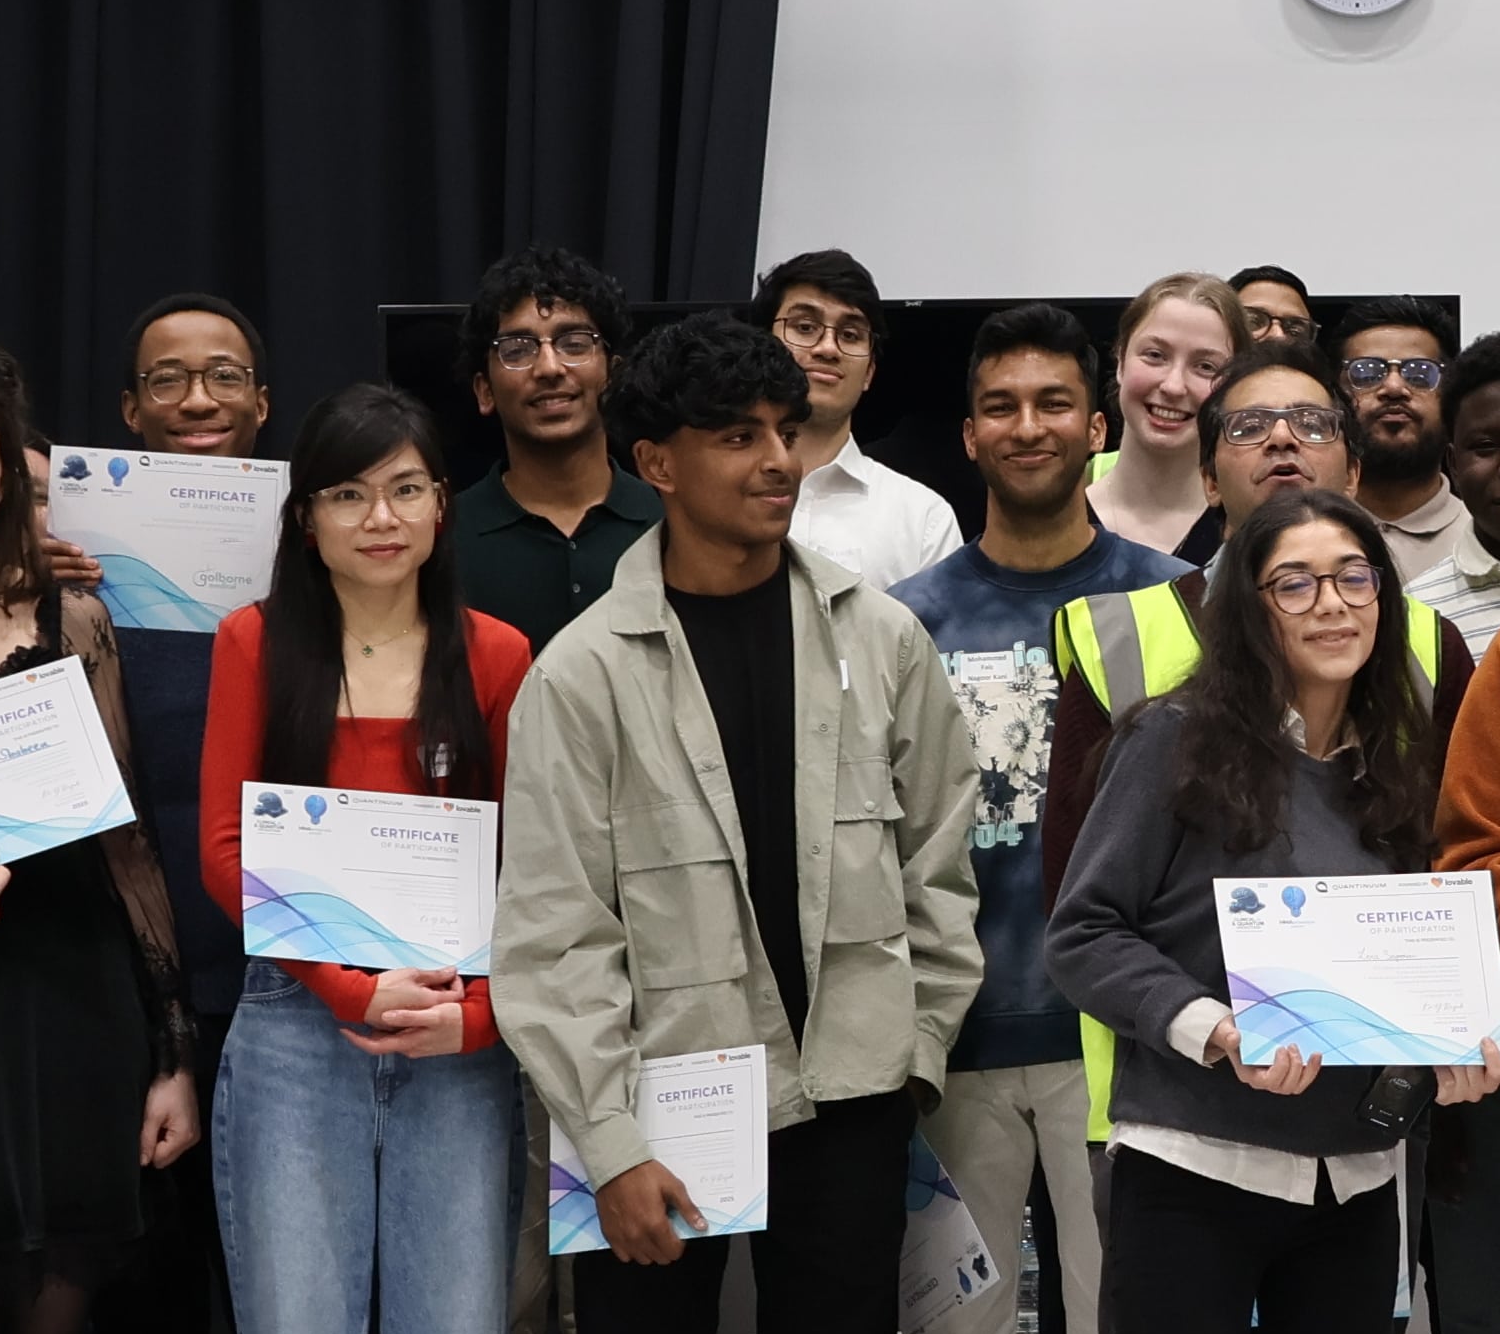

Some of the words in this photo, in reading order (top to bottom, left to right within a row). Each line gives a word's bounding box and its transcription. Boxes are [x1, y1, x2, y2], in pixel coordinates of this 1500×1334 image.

[170, 487, 256, 503] CERTIFICATE
[192, 569, 252, 587] golborne
[371, 827, 459, 843] CERTIFICATE
[1332, 882, 1387, 891] QUANTINUUM
[1445, 878, 1473, 886] lovable
[1356, 909, 1453, 923] CERTIFICATE
[1370, 927, 1382, 935] OF
[1384, 925, 1455, 934] PARTICIPATION
[657, 1084, 734, 1103] CERTIFICATE
